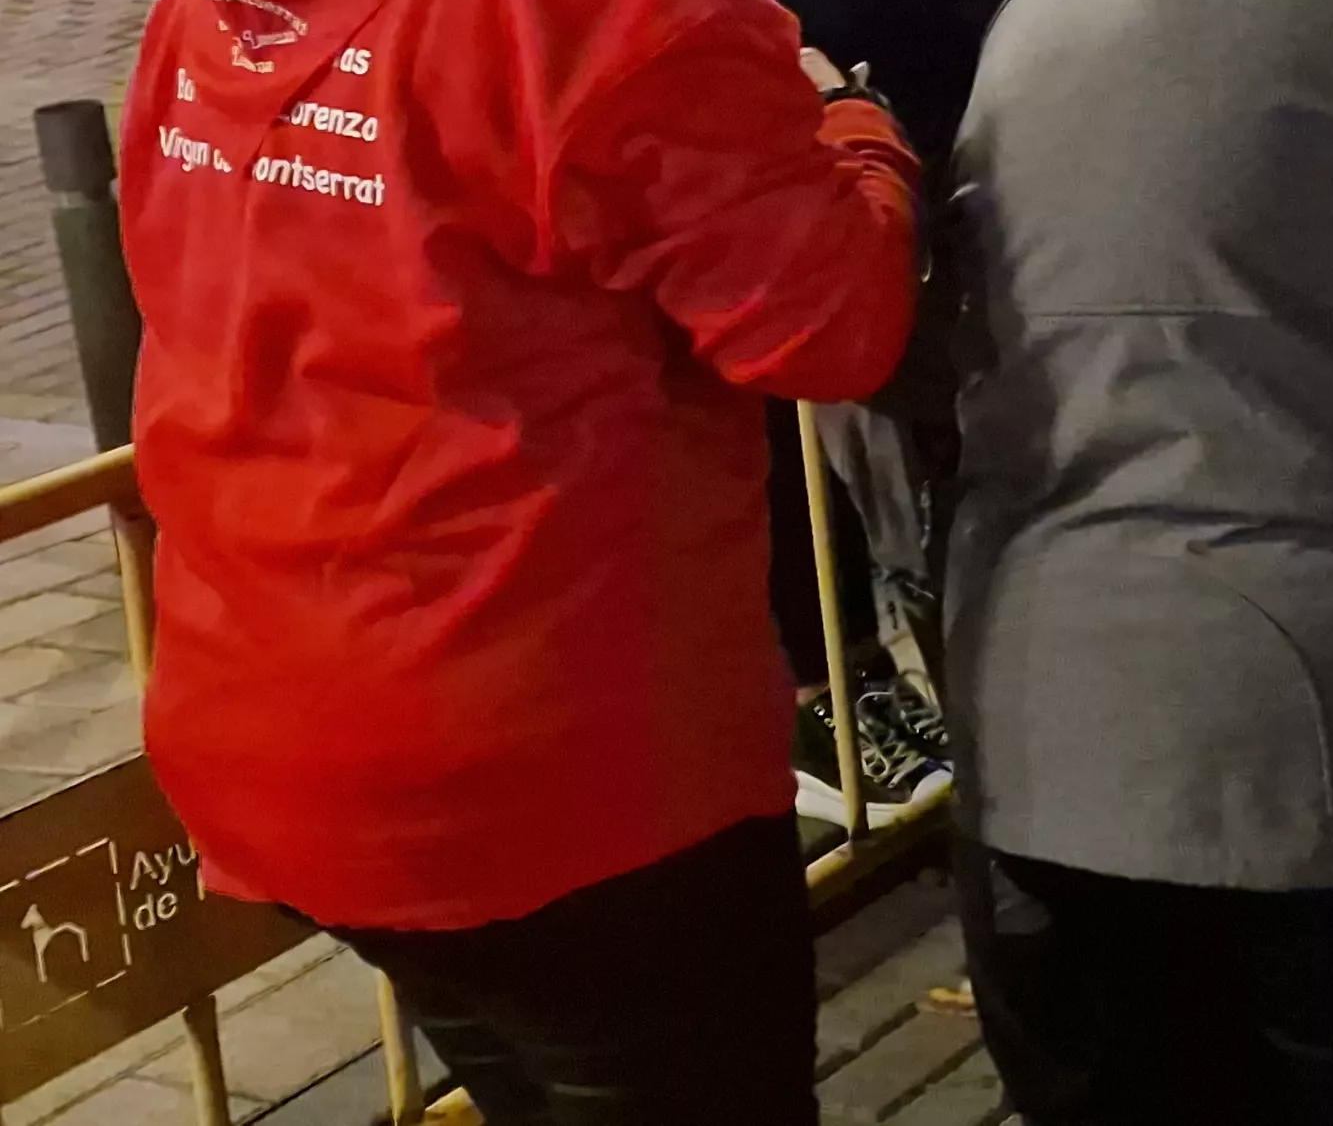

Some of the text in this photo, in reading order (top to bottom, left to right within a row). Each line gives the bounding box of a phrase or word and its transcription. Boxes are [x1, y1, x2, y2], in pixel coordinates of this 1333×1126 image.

[333, 48, 372, 75] as
[278, 102, 378, 142] orenzo
[253, 154, 386, 207] ontserrat
[129, 842, 197, 891] Ayu
[133, 891, 179, 932] de
